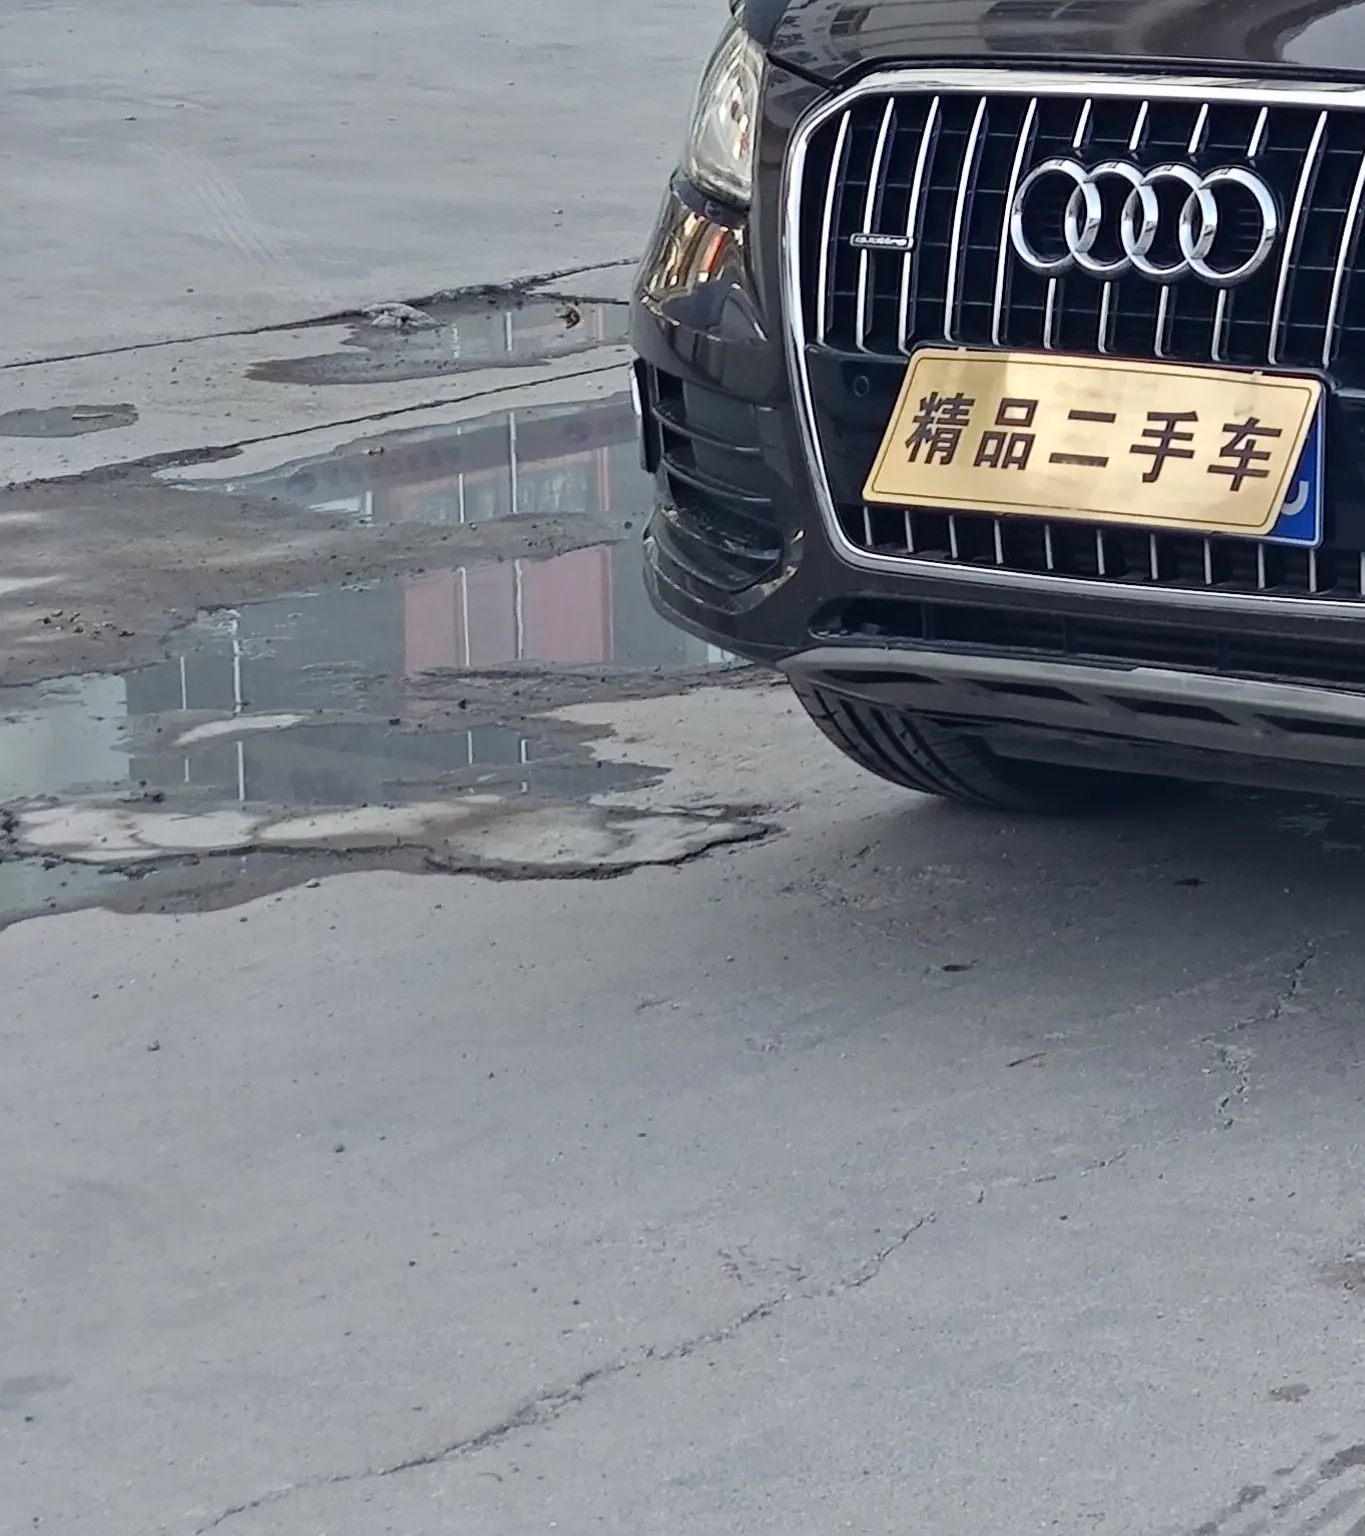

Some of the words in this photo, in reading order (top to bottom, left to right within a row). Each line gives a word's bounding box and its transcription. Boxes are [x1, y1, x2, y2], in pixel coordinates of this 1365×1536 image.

[905, 391, 1283, 492] 精品二手车
